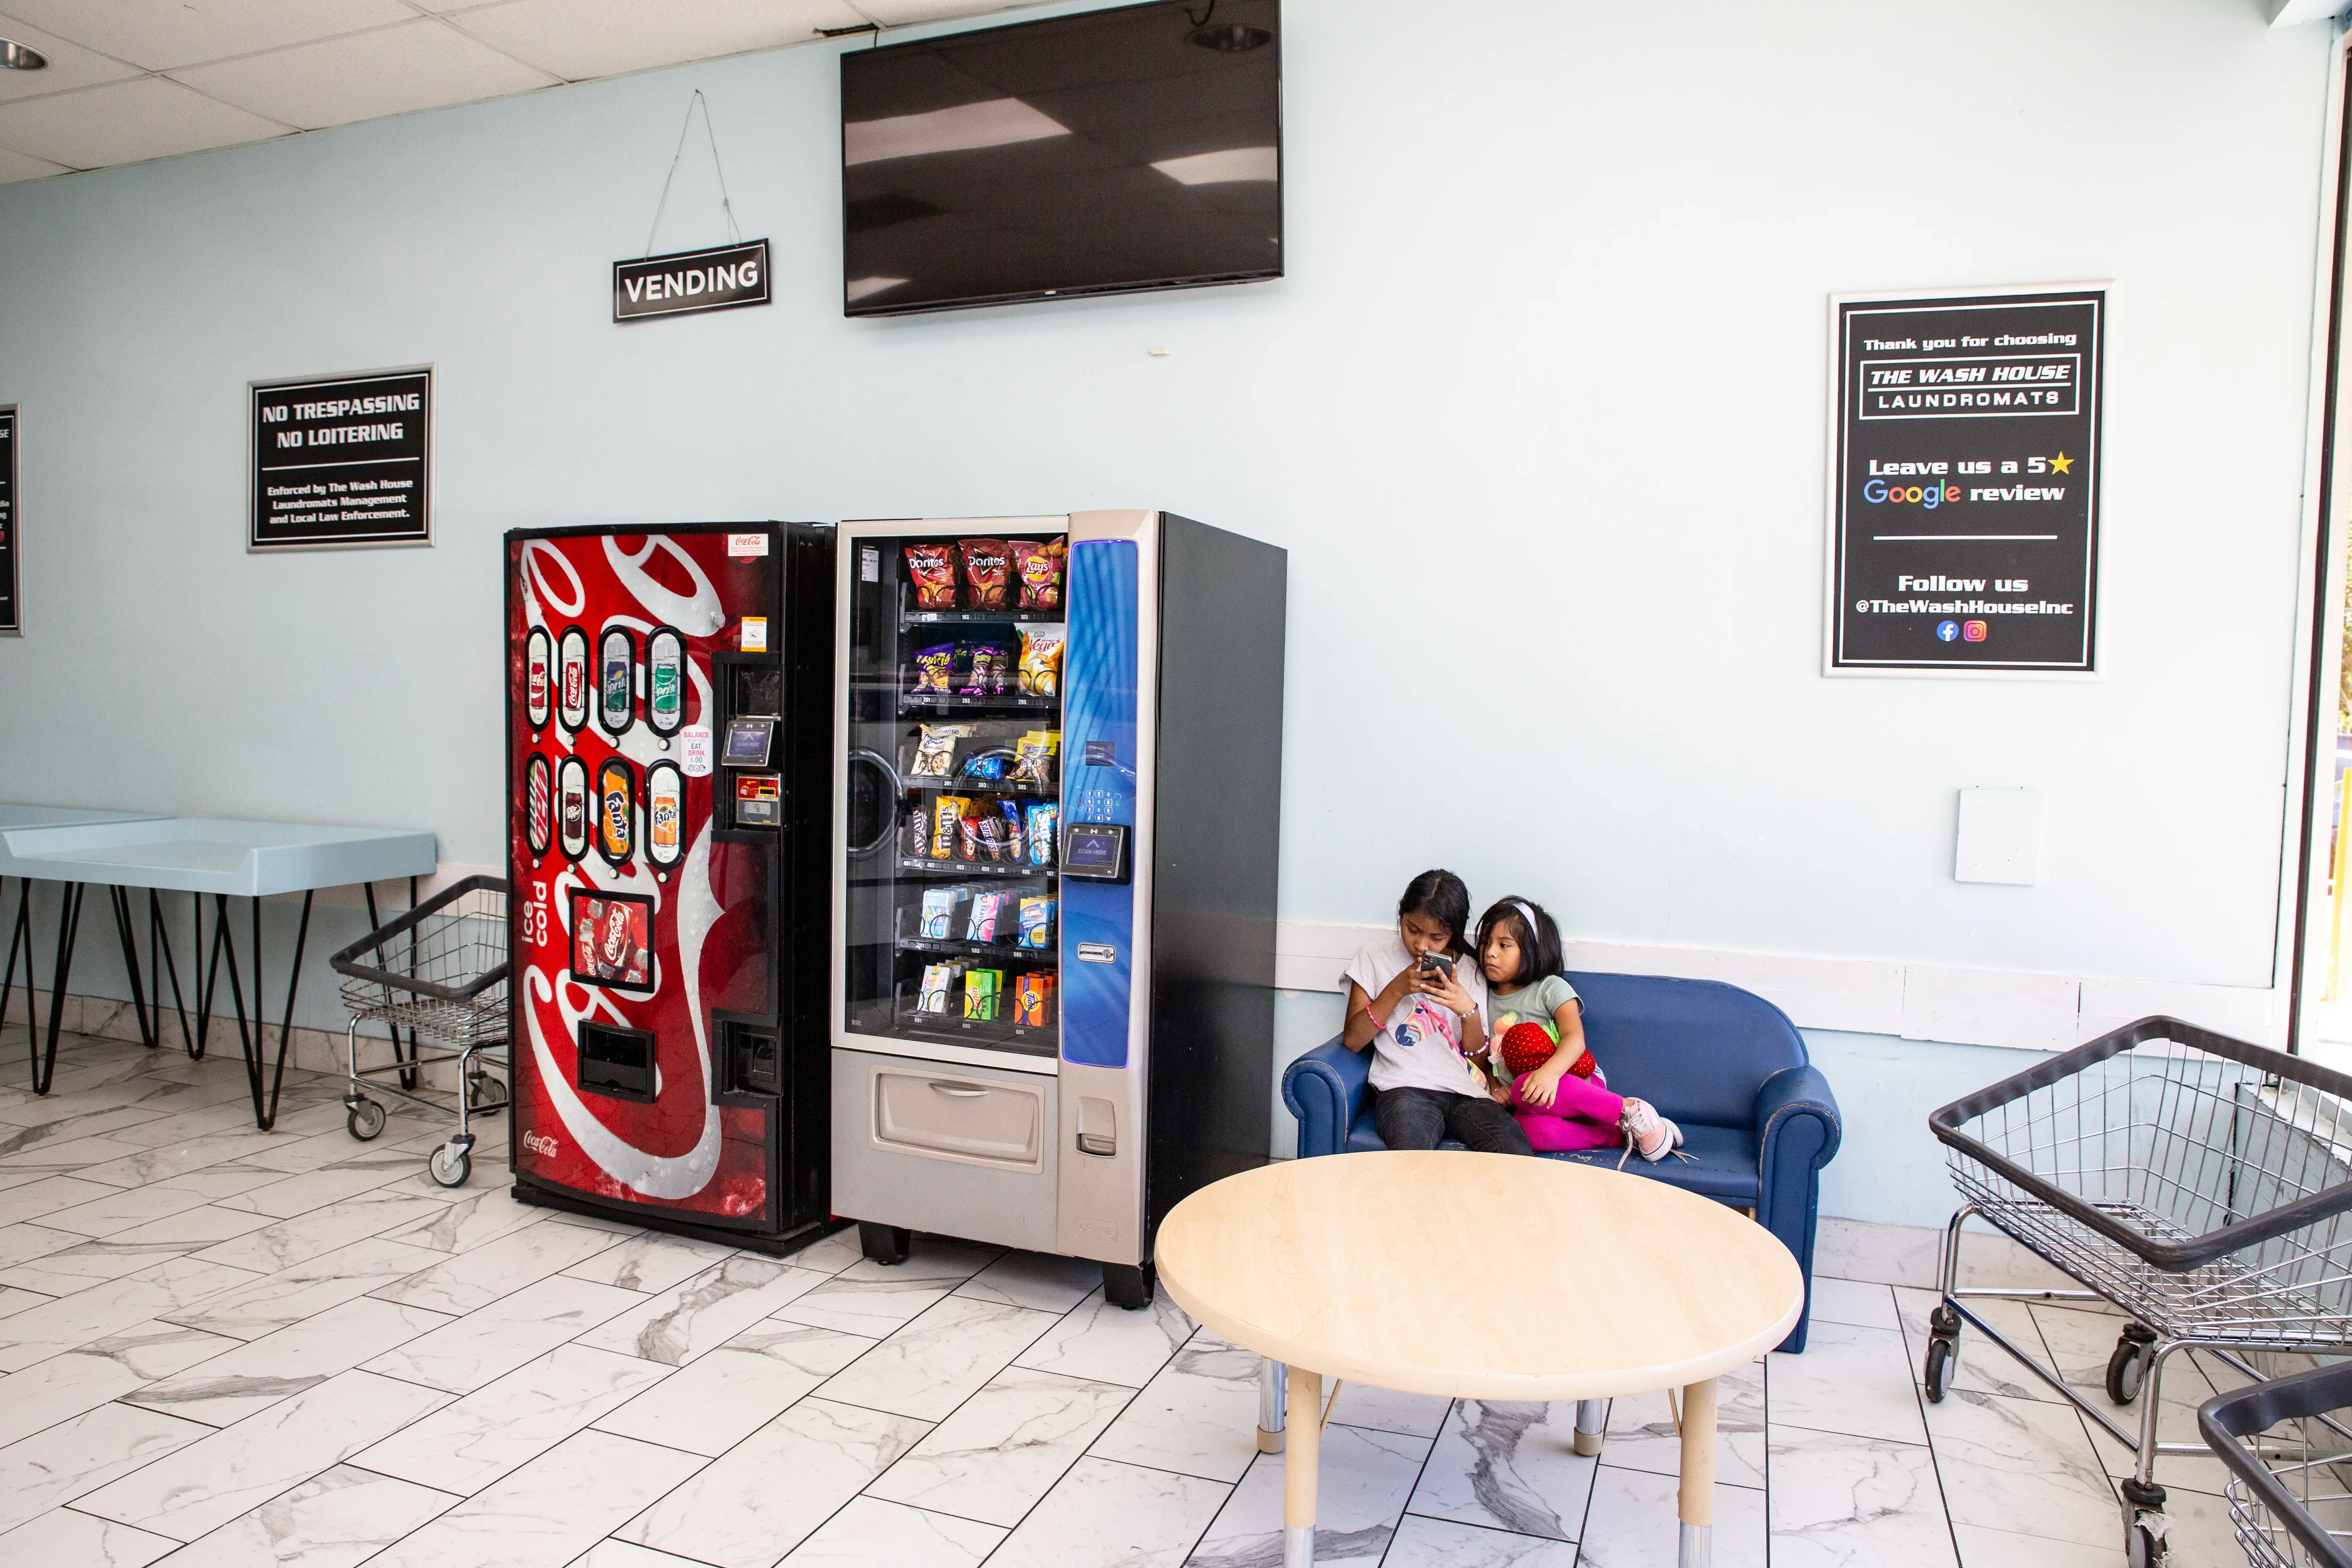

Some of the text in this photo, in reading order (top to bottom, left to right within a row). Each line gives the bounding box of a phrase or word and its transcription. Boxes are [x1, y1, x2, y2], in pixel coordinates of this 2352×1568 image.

[625, 261, 758, 303] VENDING
[1863, 333, 2077, 351] Thank you for choosing
[1871, 365, 2071, 385] THE WASH HOUSE
[263, 393, 420, 423] NO TRESPASSING
[1878, 391, 2059, 408] LAUNDROMATS
[277, 423, 403, 448] NO LOITERING
[1869, 457, 2046, 476] Leave us a 5
[267, 479, 413, 496] Enforced by The Wash House
[1863, 479, 2065, 509] Google review
[272, 494, 407, 510] Laundromats Management
[270, 509, 410, 524] and Local Law Enforcement.
[909, 558, 944, 569] Doritos
[968, 556, 1005, 566] Doritos
[1898, 575, 2029, 592] Follow us
[1856, 600, 2074, 614] @TheWashHouseInc
[605, 791, 628, 840] Fanta
[654, 809, 675, 826] Fanta
[980, 823, 997, 851] SATISFIES
[522, 900, 533, 943] ice
[533, 881, 547, 947] cold
[1026, 993, 1036, 1010] Tide
[524, 1130, 559, 1158] Coca-Cola
